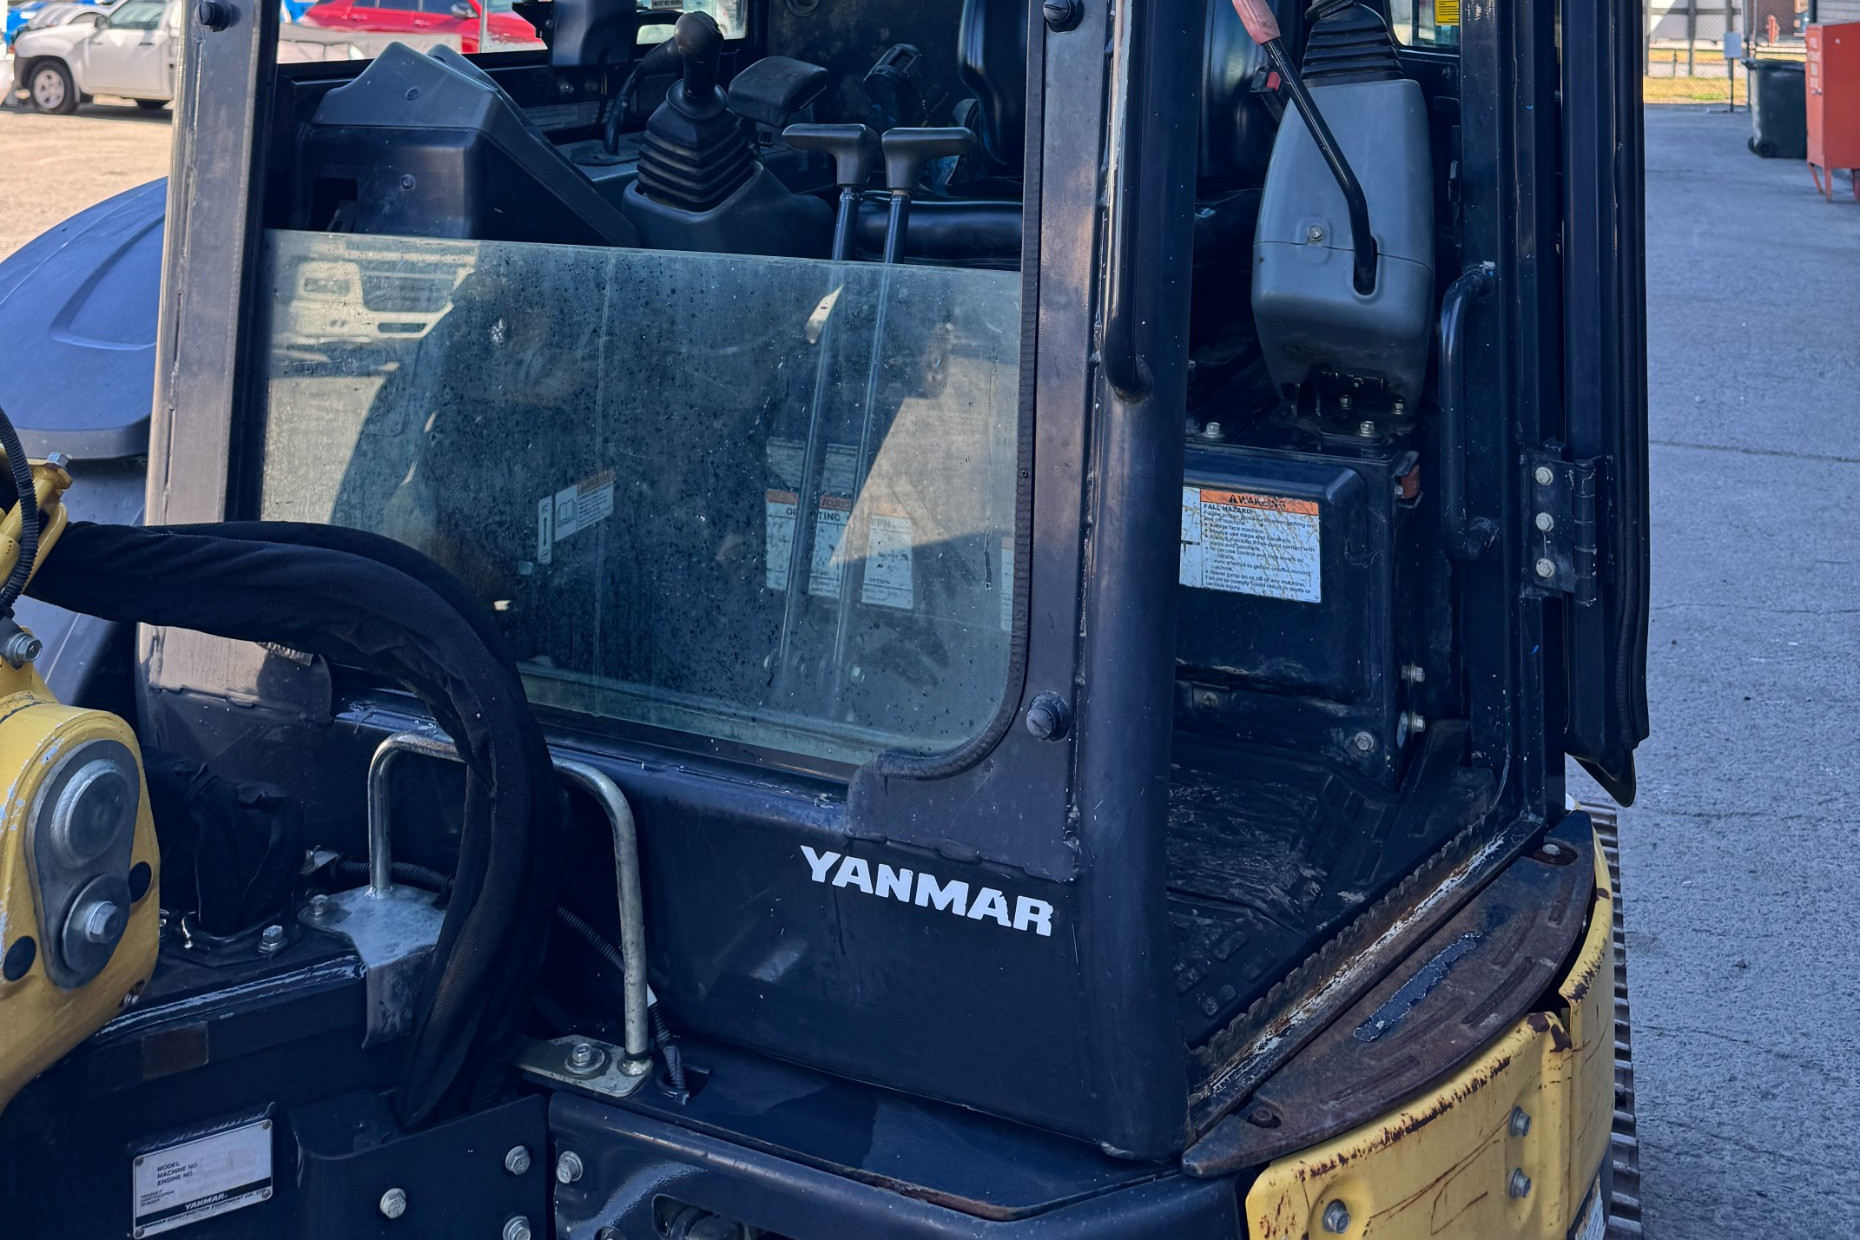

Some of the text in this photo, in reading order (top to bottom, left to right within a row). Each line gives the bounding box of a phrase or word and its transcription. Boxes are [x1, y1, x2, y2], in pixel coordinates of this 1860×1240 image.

[799, 844, 1055, 938] YANMAR
[157, 1161, 180, 1171] MODEL
[157, 1165, 187, 1179] MACHINE
[157, 1174, 181, 1186] ENGINE
